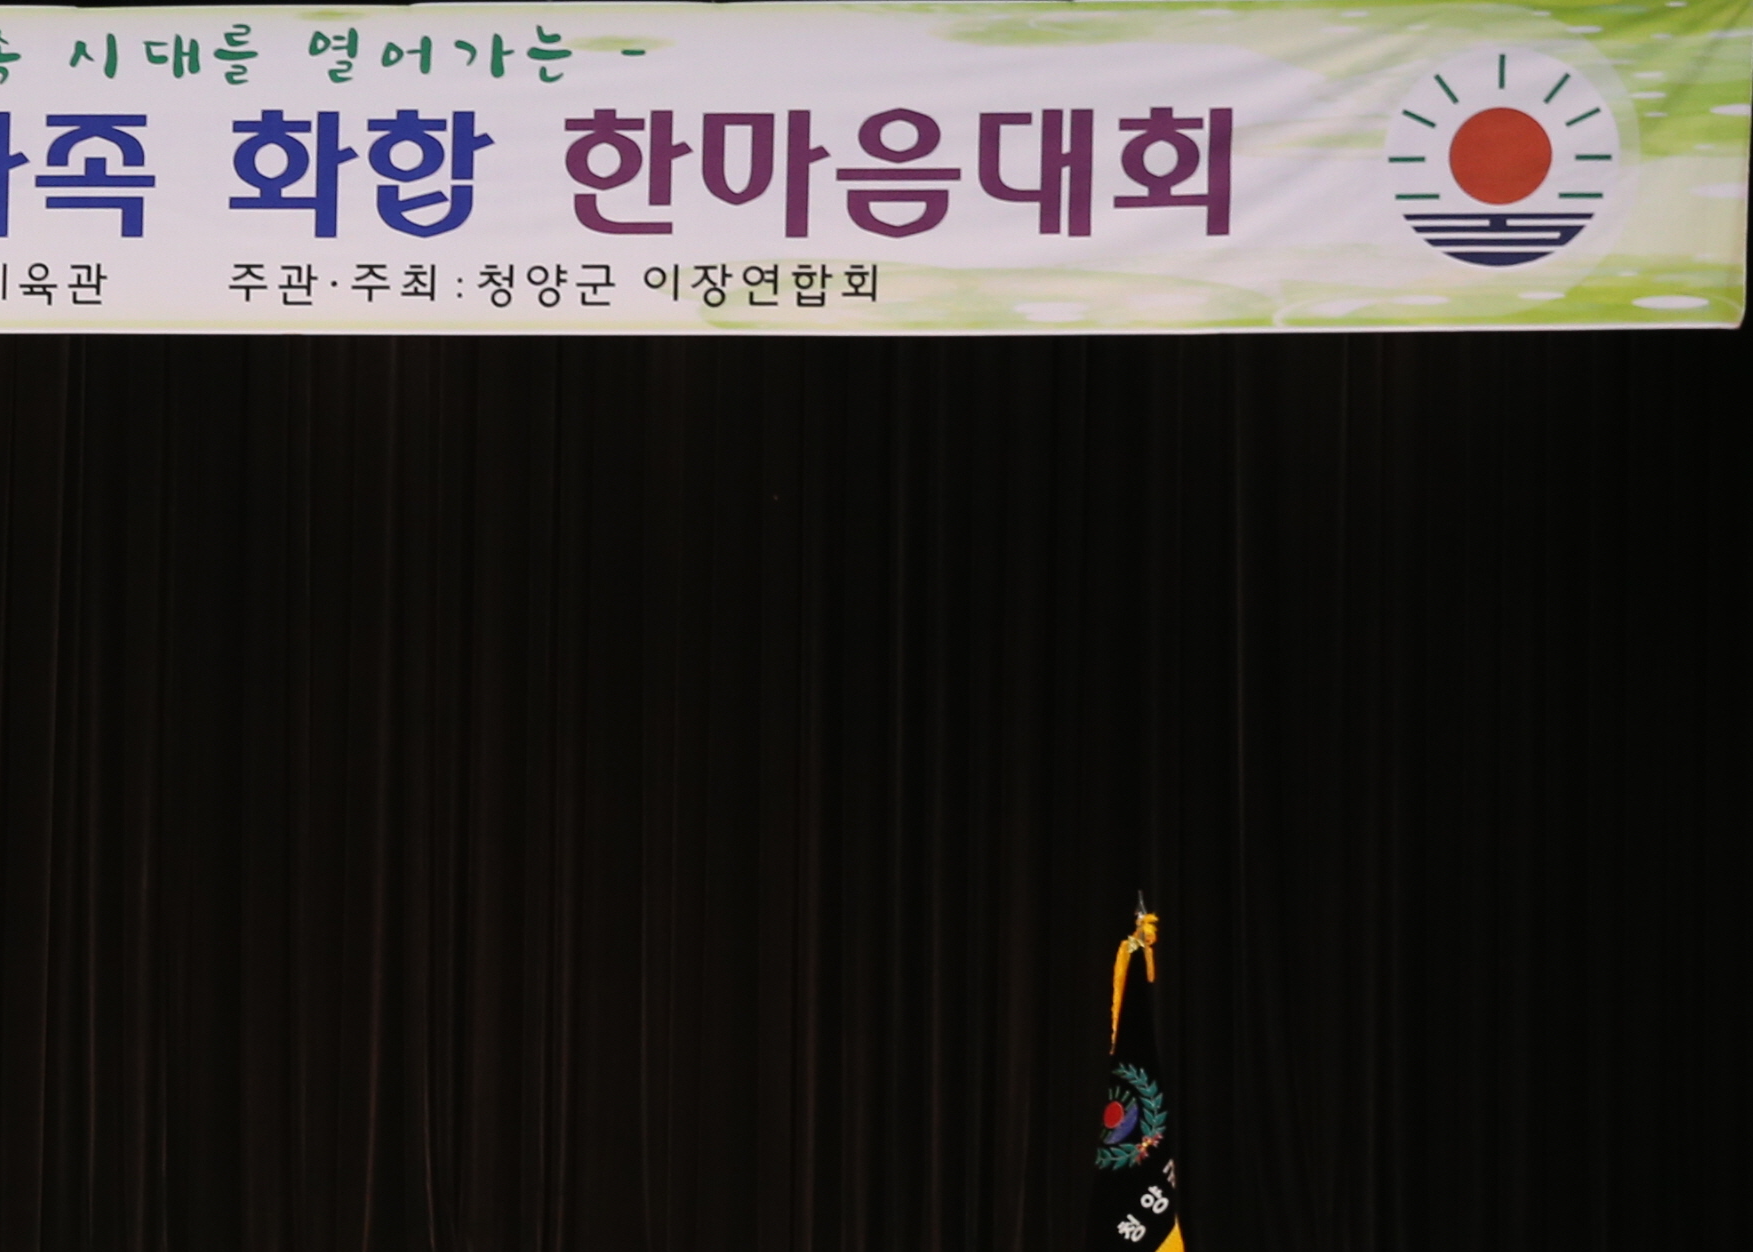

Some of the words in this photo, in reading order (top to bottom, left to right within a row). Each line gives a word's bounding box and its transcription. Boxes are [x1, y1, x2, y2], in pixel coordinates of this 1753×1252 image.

[70, 23, 259, 85] 시대를
[309, 25, 574, 84] 열어가는
[228, 109, 495, 239] 화합
[564, 107, 1233, 239] 한마음대회
[477, 263, 616, 308] 청양군
[643, 263, 878, 309] 이장연합회
